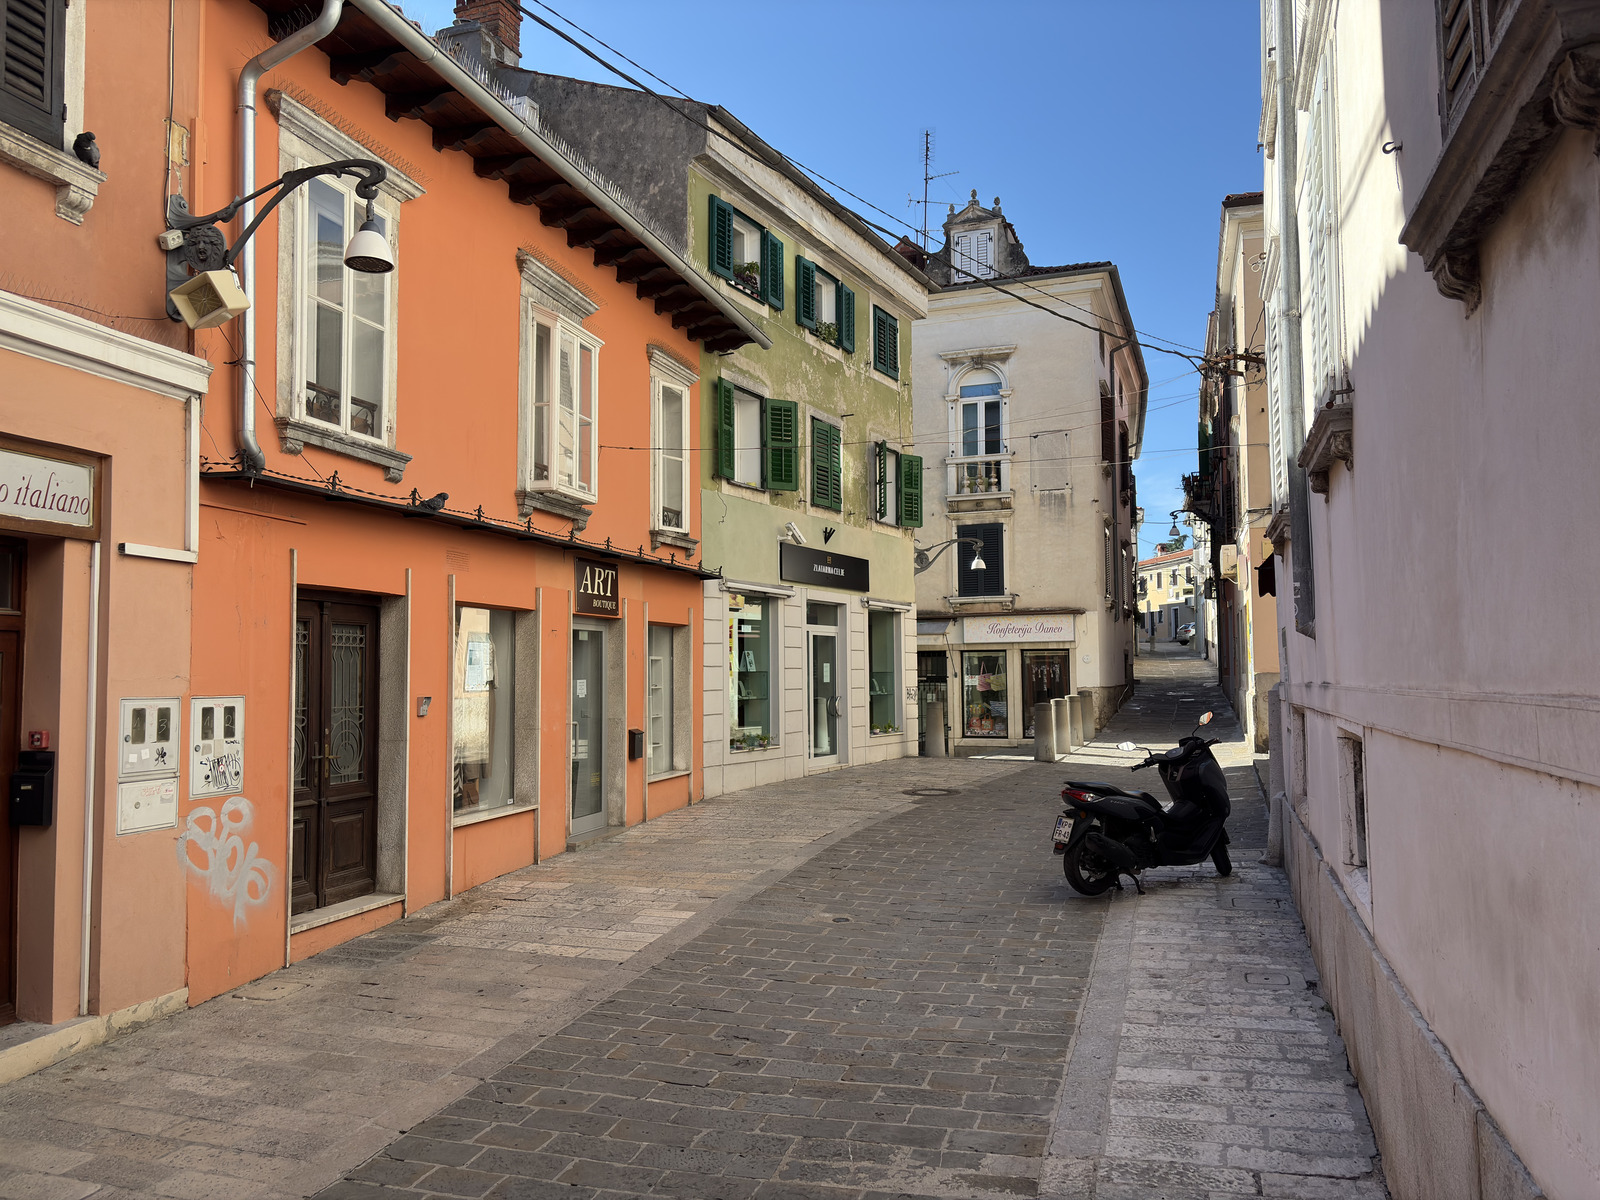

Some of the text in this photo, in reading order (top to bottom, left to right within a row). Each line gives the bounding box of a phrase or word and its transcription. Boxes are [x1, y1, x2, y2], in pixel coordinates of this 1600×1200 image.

[13, 471, 90, 515] italiano
[579, 565, 616, 597] ART
[592, 598, 617, 611] BOUTIQUE
[986, 622, 1033, 639] Konfeterija
